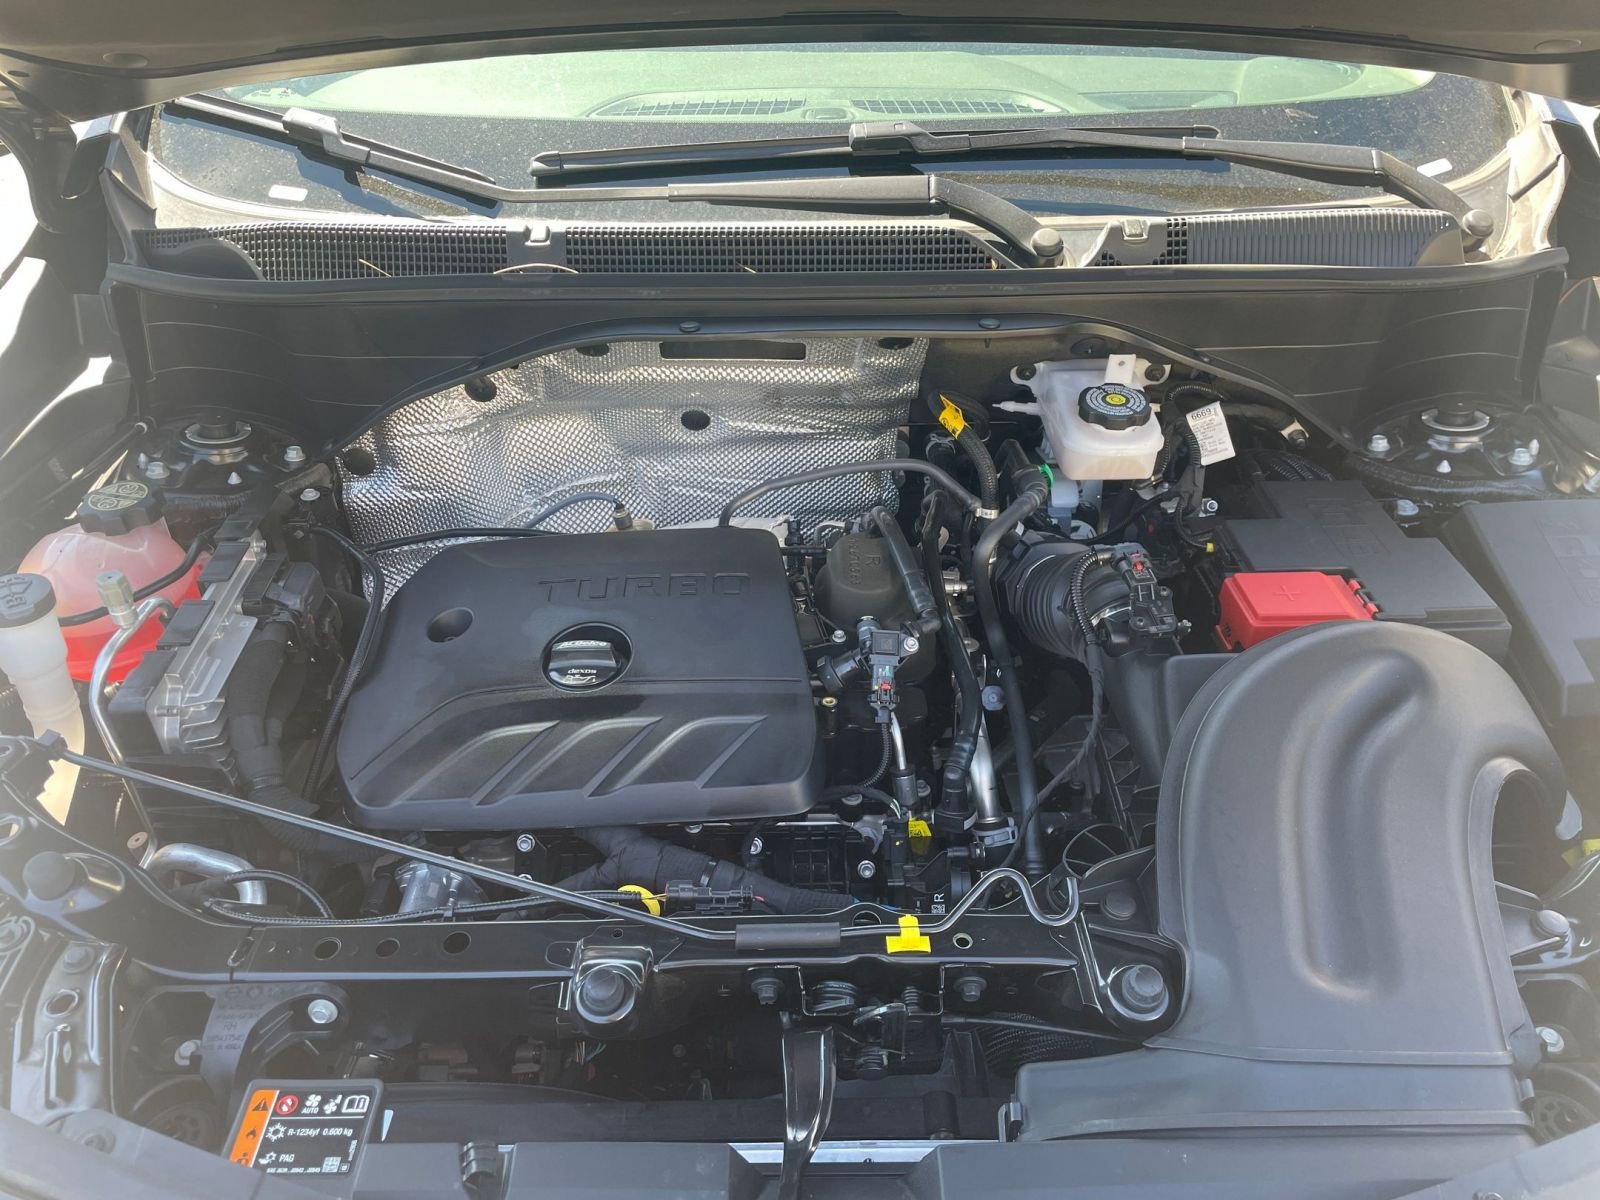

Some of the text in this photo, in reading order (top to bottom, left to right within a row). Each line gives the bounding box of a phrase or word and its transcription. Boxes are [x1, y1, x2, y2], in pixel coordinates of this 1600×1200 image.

[1191, 407, 1212, 420] 6669
[538, 572, 749, 602] TURBO
[933, 893, 945, 902] R
[287, 1128, 320, 1137] R-1234yf
[343, 1128, 353, 1137] kg
[278, 1154, 295, 1163] PAG
